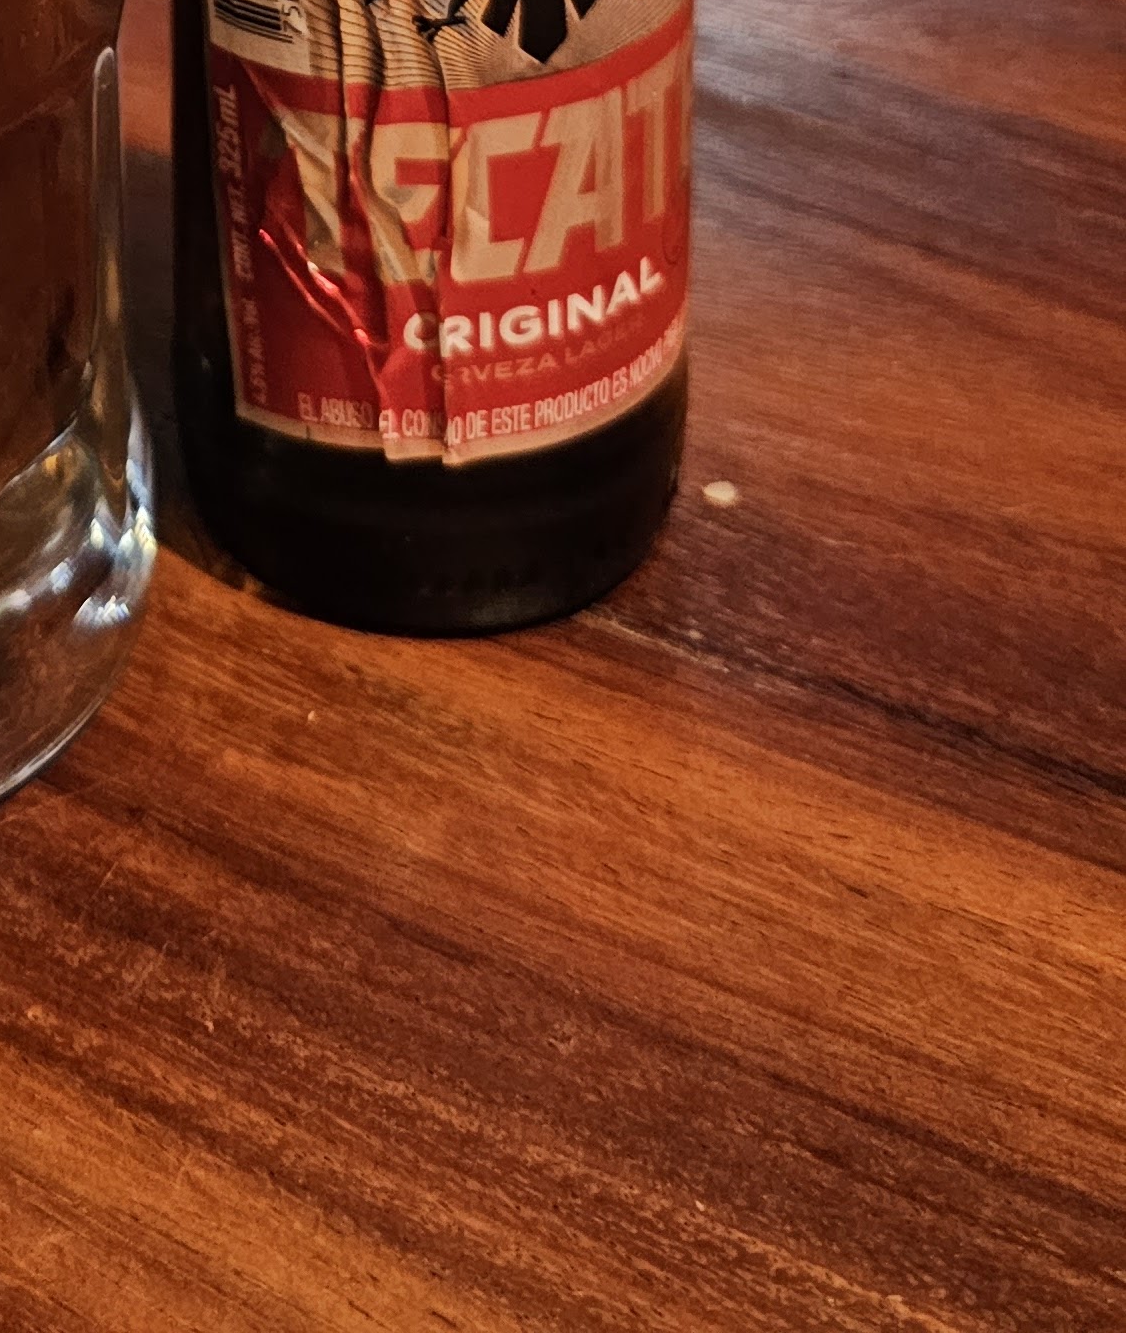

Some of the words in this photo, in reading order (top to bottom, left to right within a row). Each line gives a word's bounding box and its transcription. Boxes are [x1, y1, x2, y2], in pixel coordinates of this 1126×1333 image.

[466, 410, 488, 440] DE
[491, 403, 531, 434] ESTE
[534, 377, 610, 429] PRODUCTO
